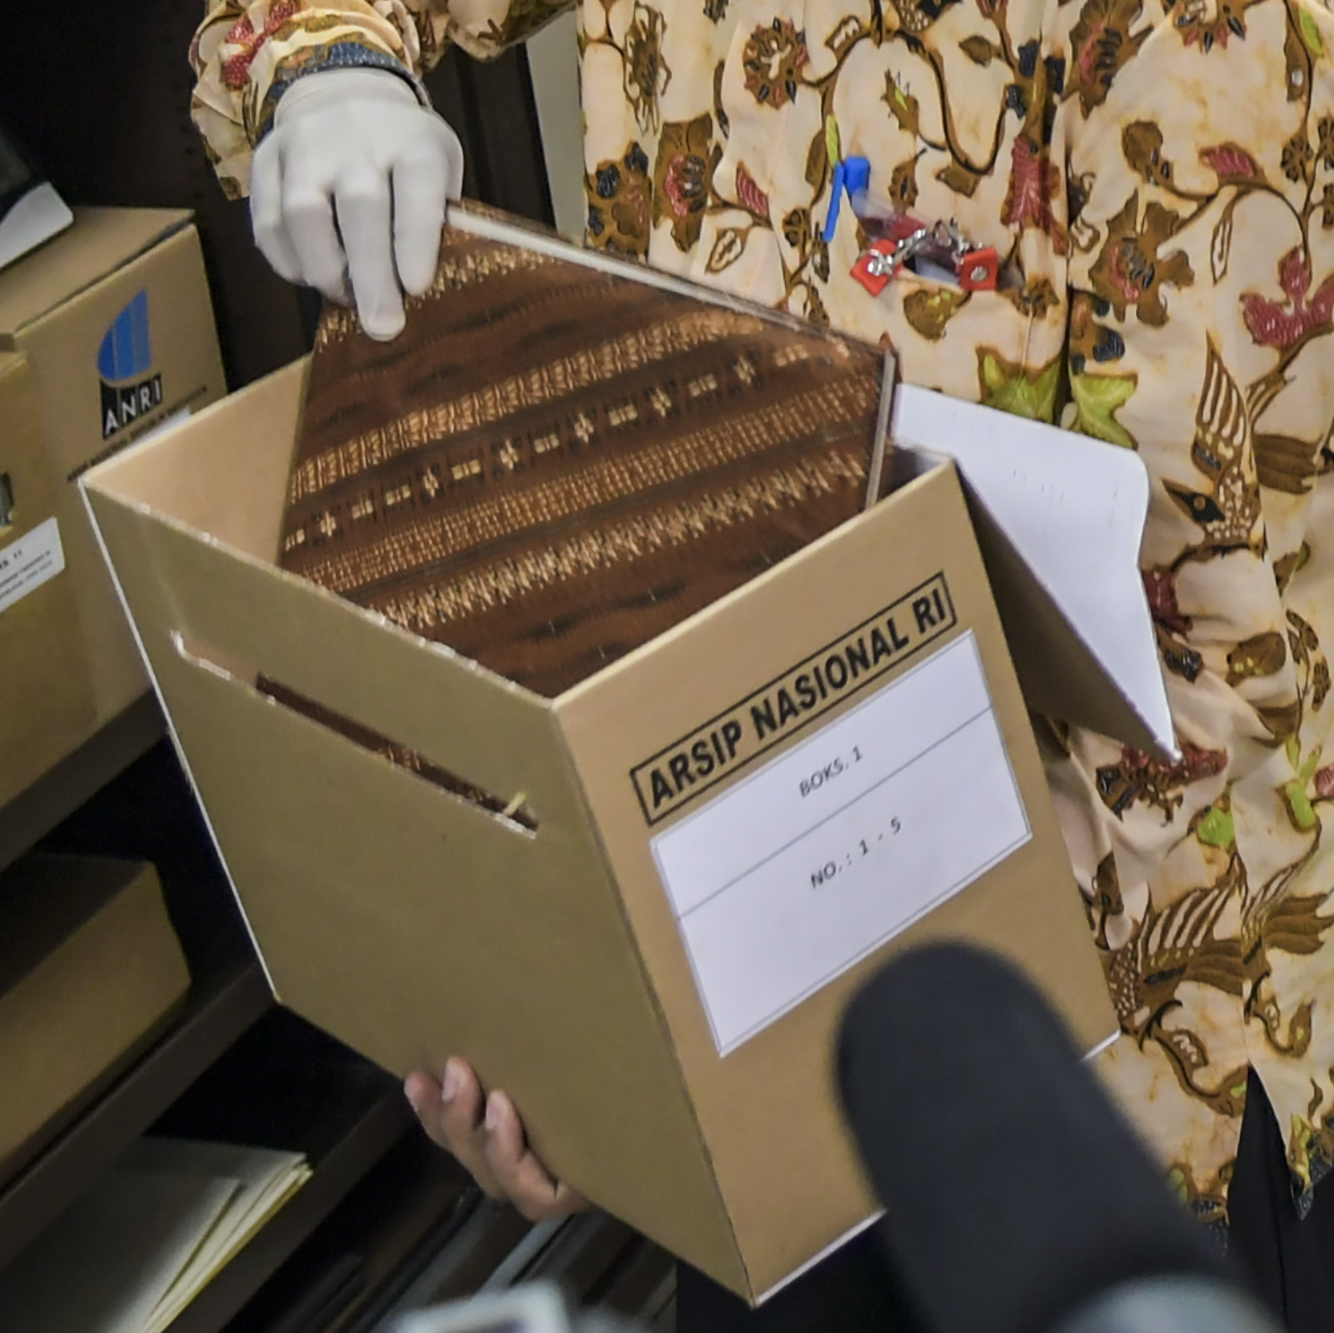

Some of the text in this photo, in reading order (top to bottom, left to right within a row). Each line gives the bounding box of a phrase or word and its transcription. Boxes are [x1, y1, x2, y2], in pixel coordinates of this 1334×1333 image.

[104, 378, 162, 436] ANRI
[648, 588, 947, 808] ARSIP NASIONAL RI
[799, 745, 862, 798] BOKS. 1
[810, 860, 843, 889] NO.
[859, 839, 869, 856] 1
[890, 816, 902, 835] 5
